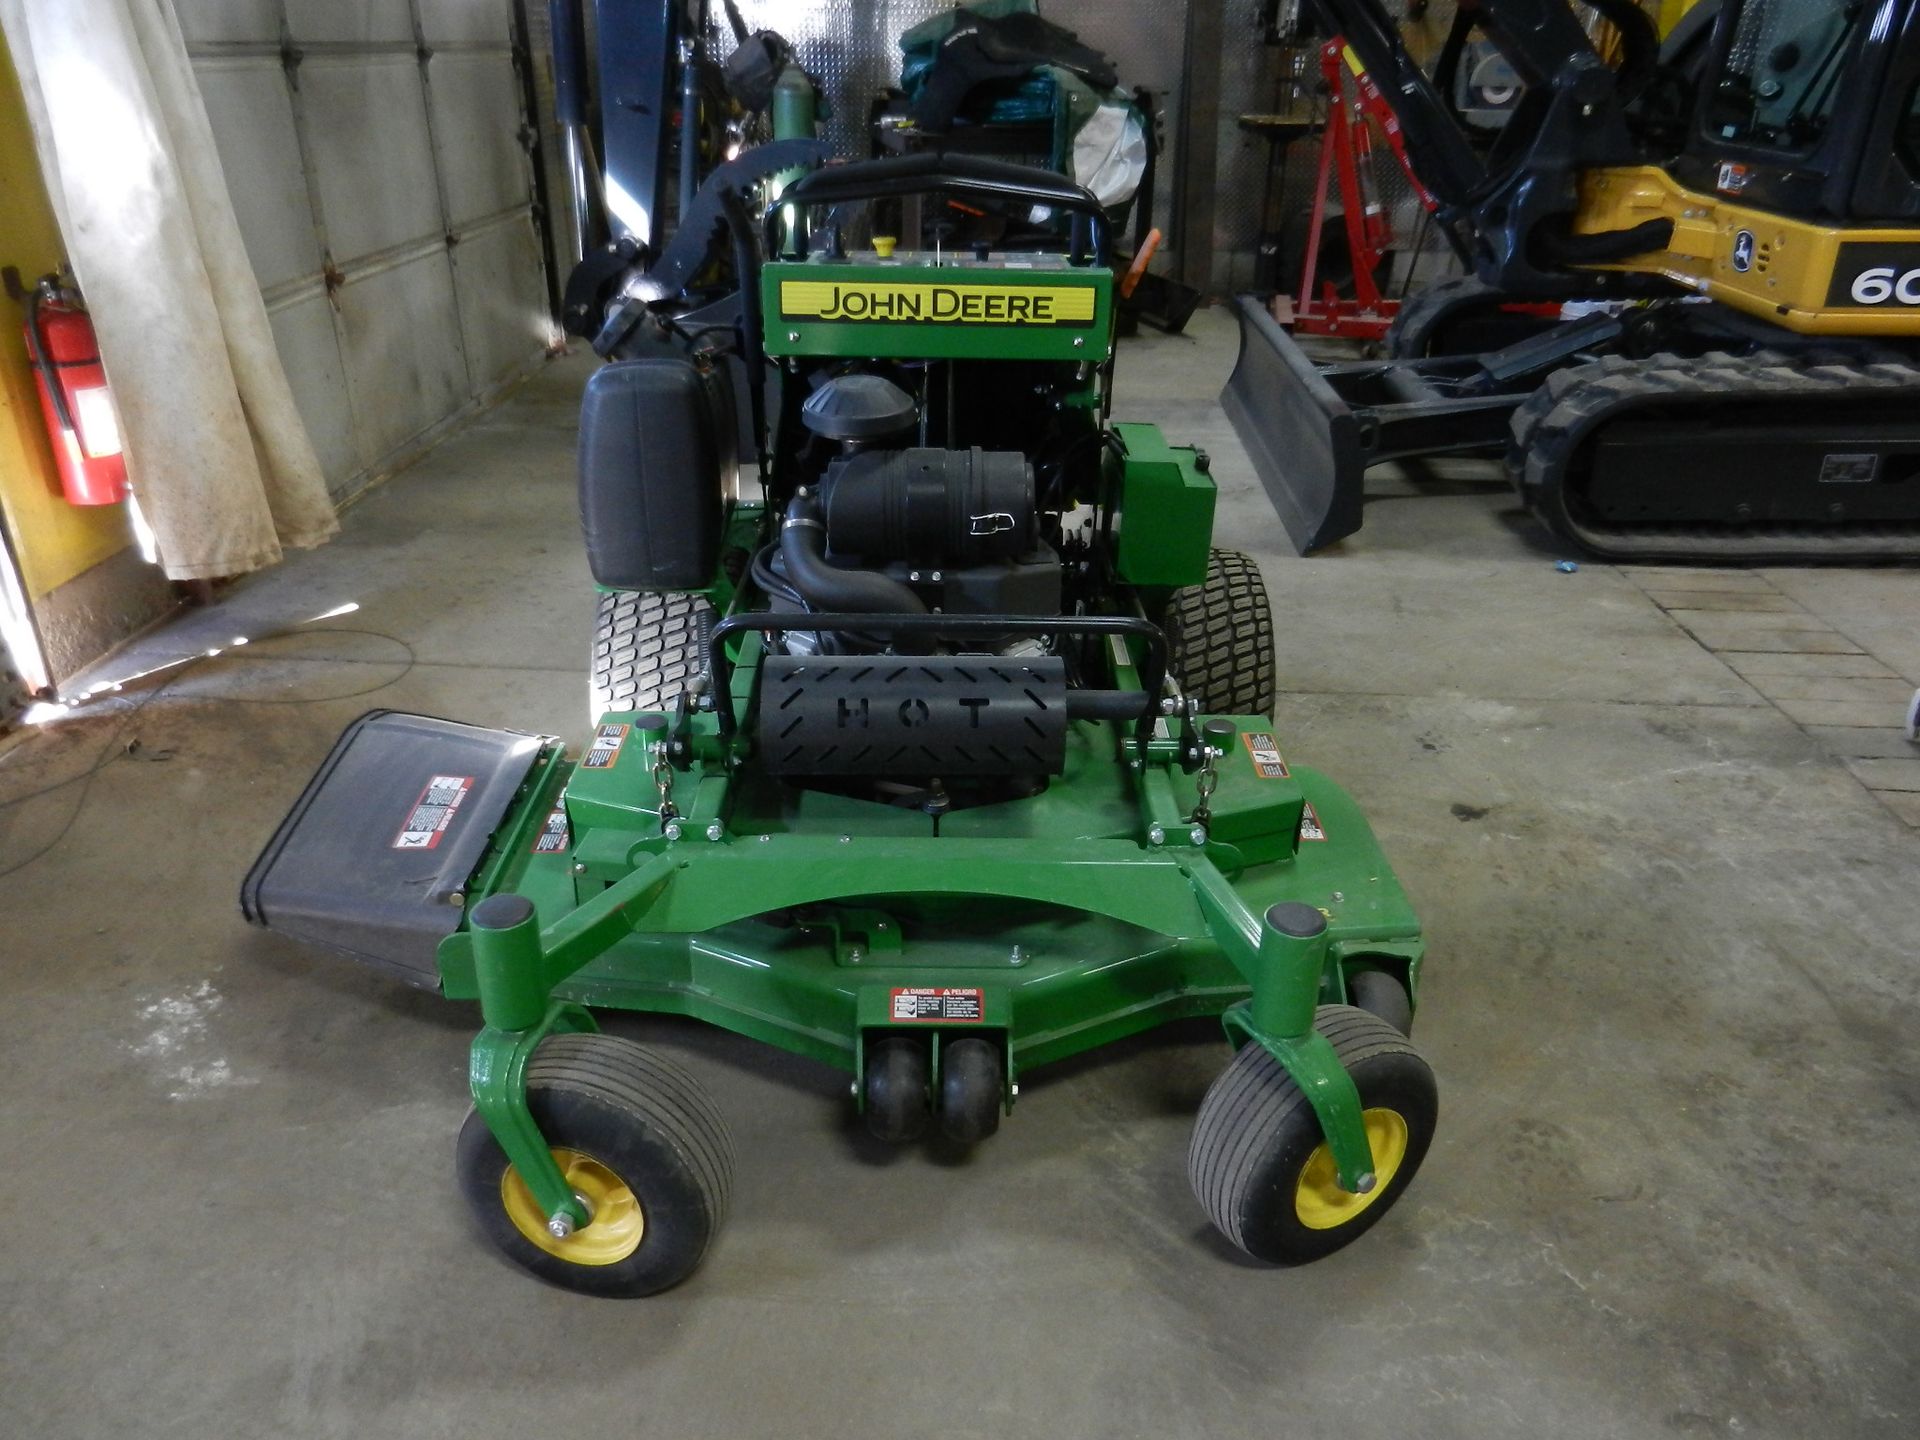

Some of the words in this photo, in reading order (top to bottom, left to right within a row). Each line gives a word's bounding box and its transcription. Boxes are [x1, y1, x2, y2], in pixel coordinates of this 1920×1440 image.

[820, 286, 921, 317] JOHN
[932, 288, 1054, 320] DEERE
[837, 697, 990, 729] HOT
